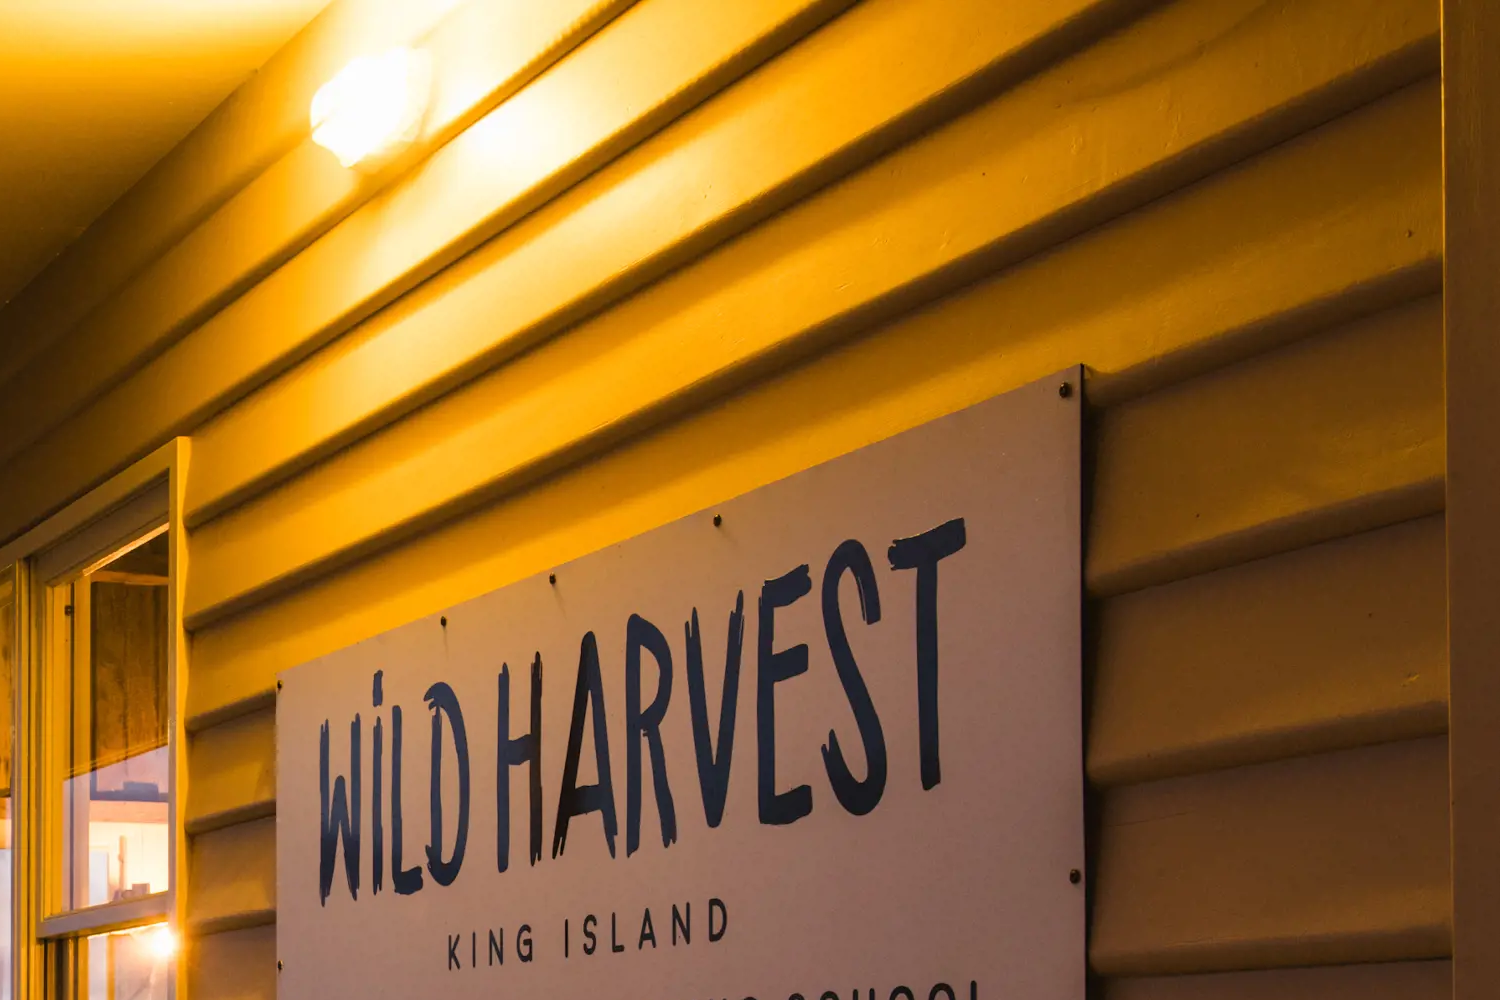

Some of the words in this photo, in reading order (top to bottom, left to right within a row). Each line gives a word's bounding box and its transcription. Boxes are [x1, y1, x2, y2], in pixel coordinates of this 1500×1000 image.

[496, 516, 968, 875] HARVEST
[447, 923, 534, 971] KING
[564, 897, 729, 959] ISLAND
